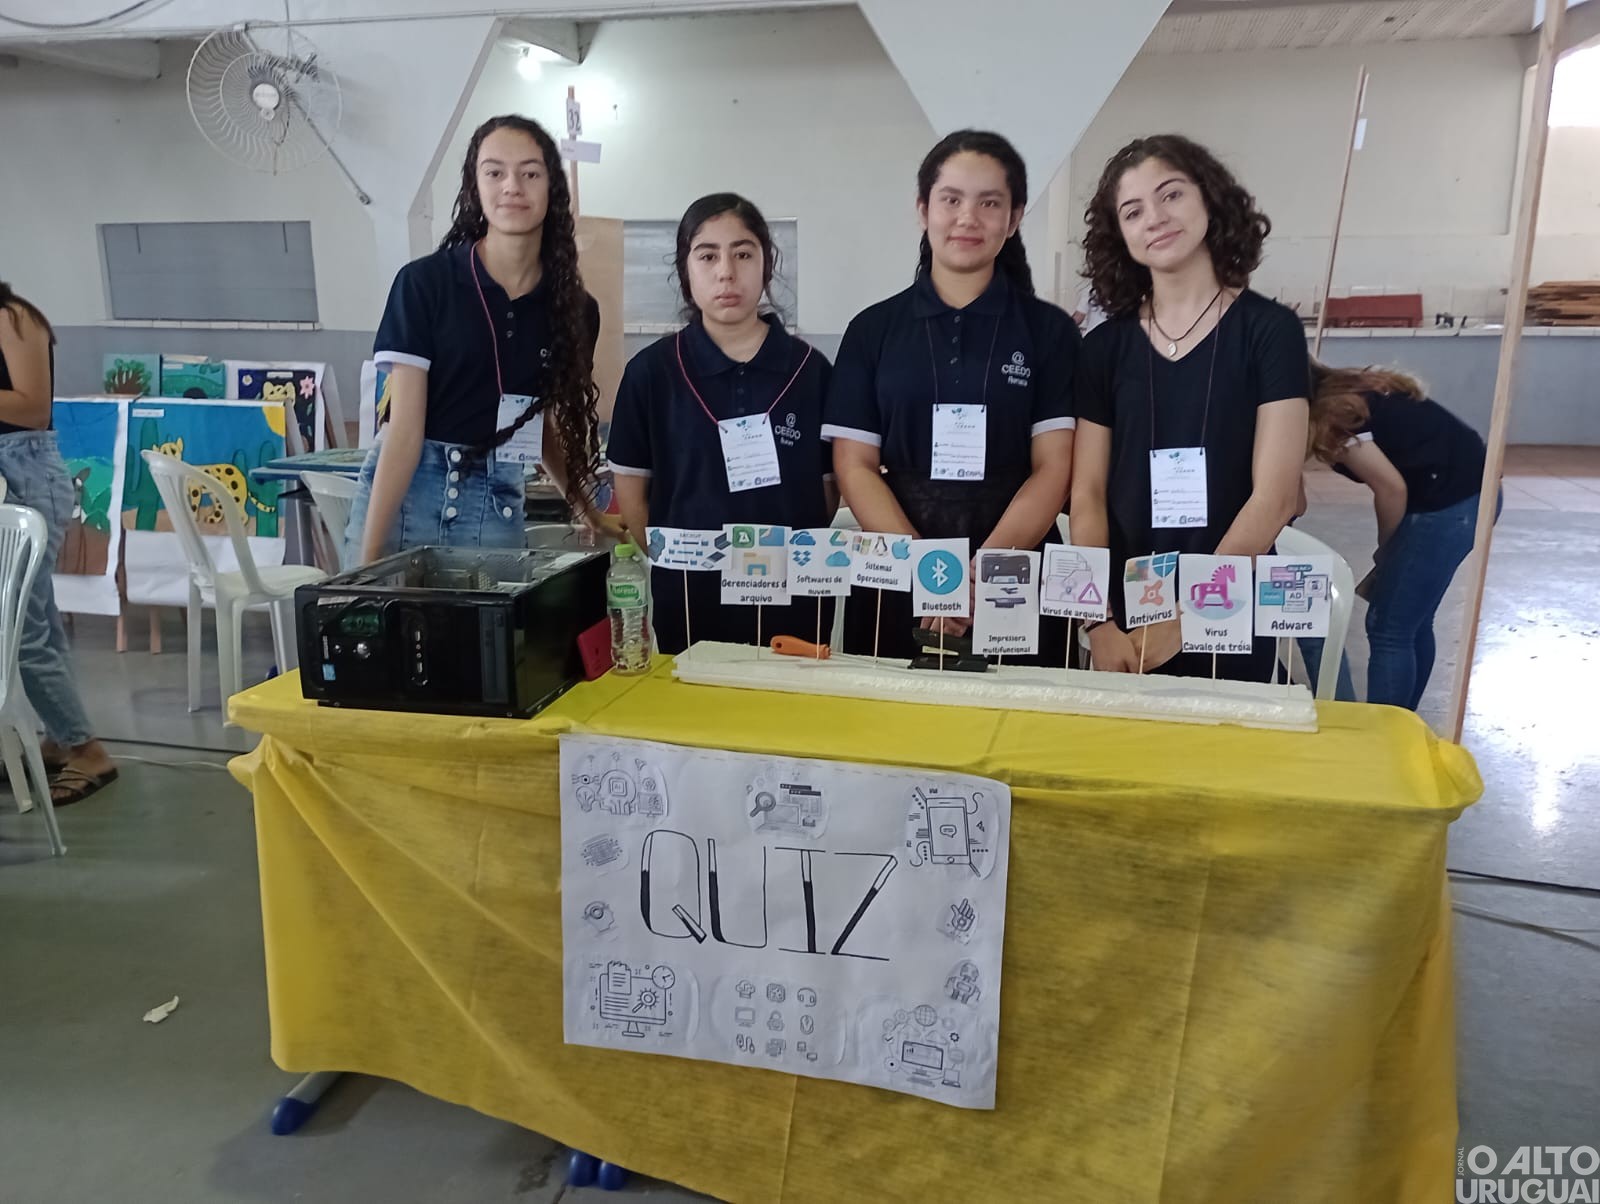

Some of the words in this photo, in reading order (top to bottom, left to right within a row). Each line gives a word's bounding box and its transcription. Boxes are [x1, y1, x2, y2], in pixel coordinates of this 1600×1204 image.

[865, 561, 892, 572] Sistemas
[721, 579, 780, 588] Gerenciadores
[796, 575, 832, 583] Softwares
[856, 573, 898, 586] Operacionais
[740, 595, 773, 605] arquivo
[922, 602, 962, 611] Bluetooth
[1063, 608, 1072, 616] de
[1074, 610, 1104, 620] arquivo
[1271, 619, 1313, 631] Adware
[988, 634, 1026, 643] Impressora
[982, 646, 1031, 654] multifuncional
[1183, 641, 1213, 651] Cavalo
[1214, 641, 1226, 651] de
[1228, 640, 1251, 651] tróia
[640, 828, 899, 962] QUIZ
